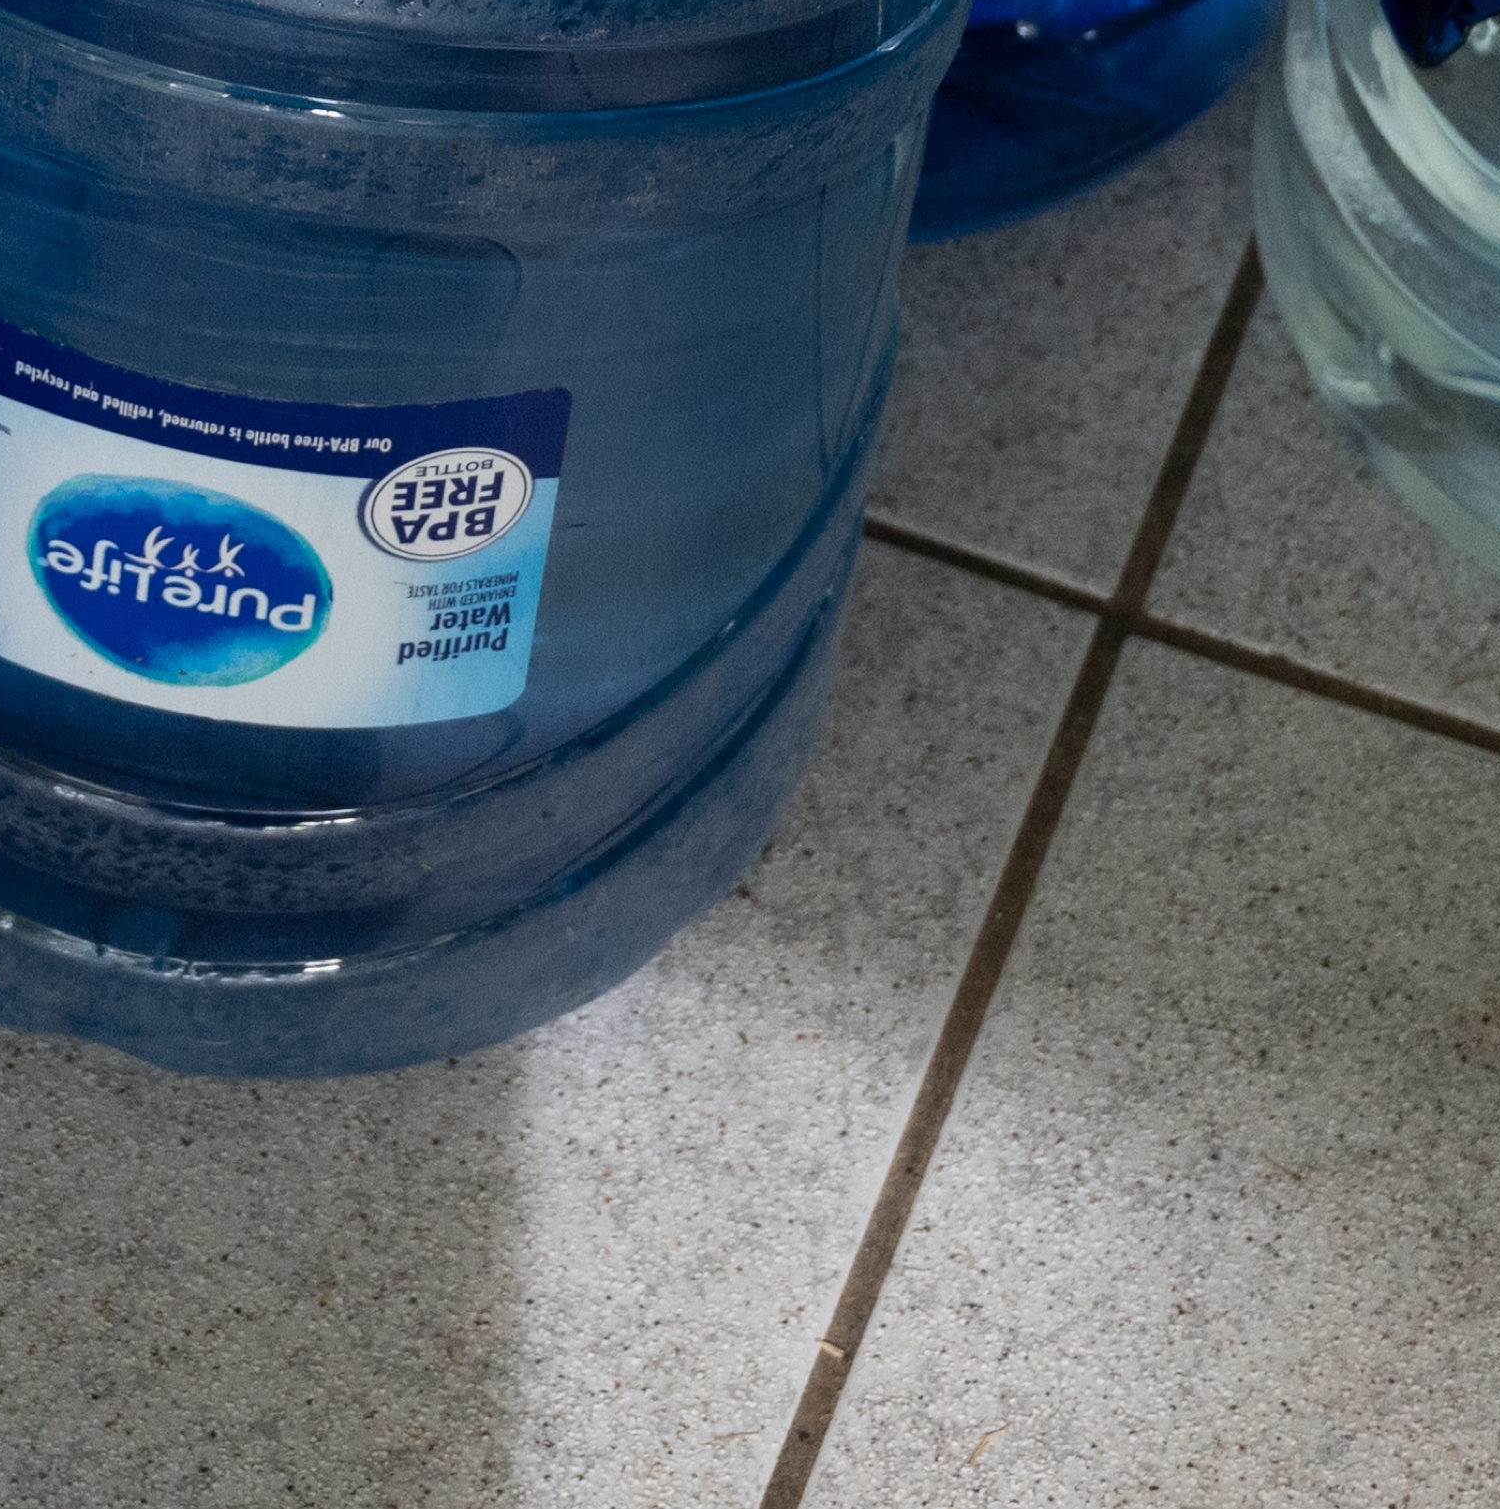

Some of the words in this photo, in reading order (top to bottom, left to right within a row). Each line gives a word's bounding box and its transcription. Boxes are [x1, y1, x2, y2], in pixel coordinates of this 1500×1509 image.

[14, 359, 71, 394] recycled
[72, 383, 99, 405] and
[102, 393, 155, 421] refilled
[156, 409, 225, 436] returned,
[228, 425, 243, 443] is
[246, 428, 291, 448] bottle
[294, 432, 361, 452] BPA-free
[364, 436, 393, 453] Our
[413, 458, 495, 477] BOTTLE
[391, 470, 505, 512] FREE
[390, 505, 497, 544] BPA
[46, 538, 150, 604] Life
[465, 569, 520, 591] MINERALS
[406, 584, 440, 600] TASTE
[441, 581, 464, 596] FOR
[459, 584, 517, 607] ENHANCED
[161, 574, 317, 633] Pure
[427, 596, 457, 611] WITH
[429, 601, 511, 631] Water
[396, 627, 509, 666] Purified
